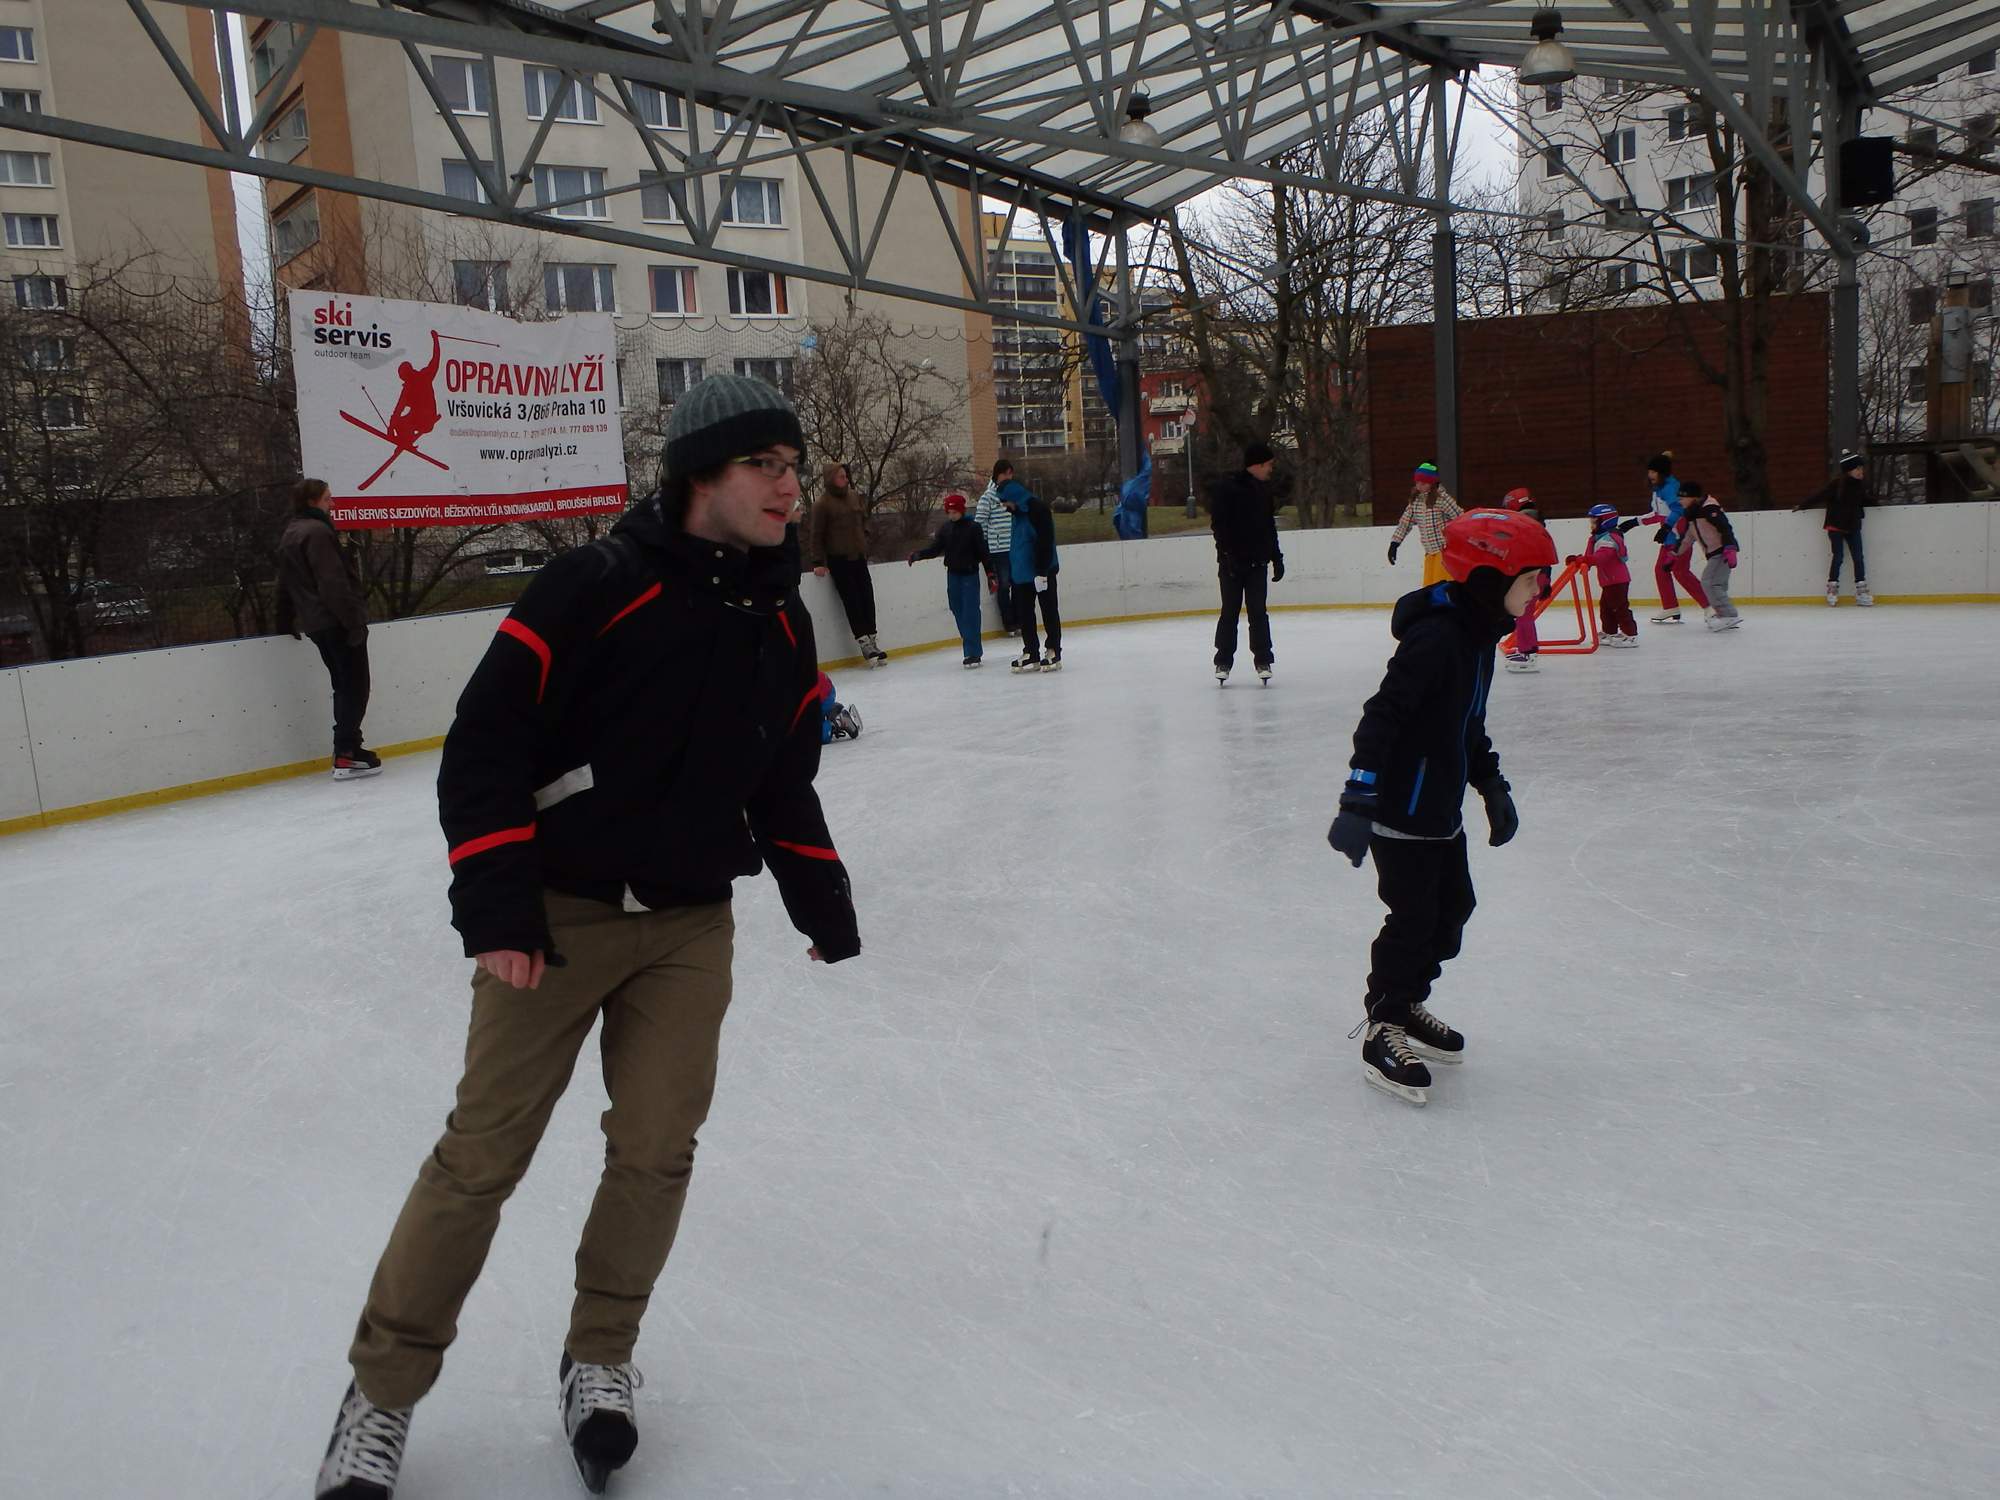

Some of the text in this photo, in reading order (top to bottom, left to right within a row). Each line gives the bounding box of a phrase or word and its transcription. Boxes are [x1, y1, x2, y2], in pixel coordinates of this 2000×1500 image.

[314, 300, 352, 326] ski
[314, 323, 392, 348] servis
[315, 350, 371, 360] outdoor team
[447, 400, 511, 419] Vršovická
[551, 400, 586, 416] Praha
[590, 399, 606, 415] 10
[358, 508, 388, 520] SERVIS
[389, 504, 443, 519] SJEZDOVÝCH,
[557, 495, 592, 510] BROUŠENÍ
